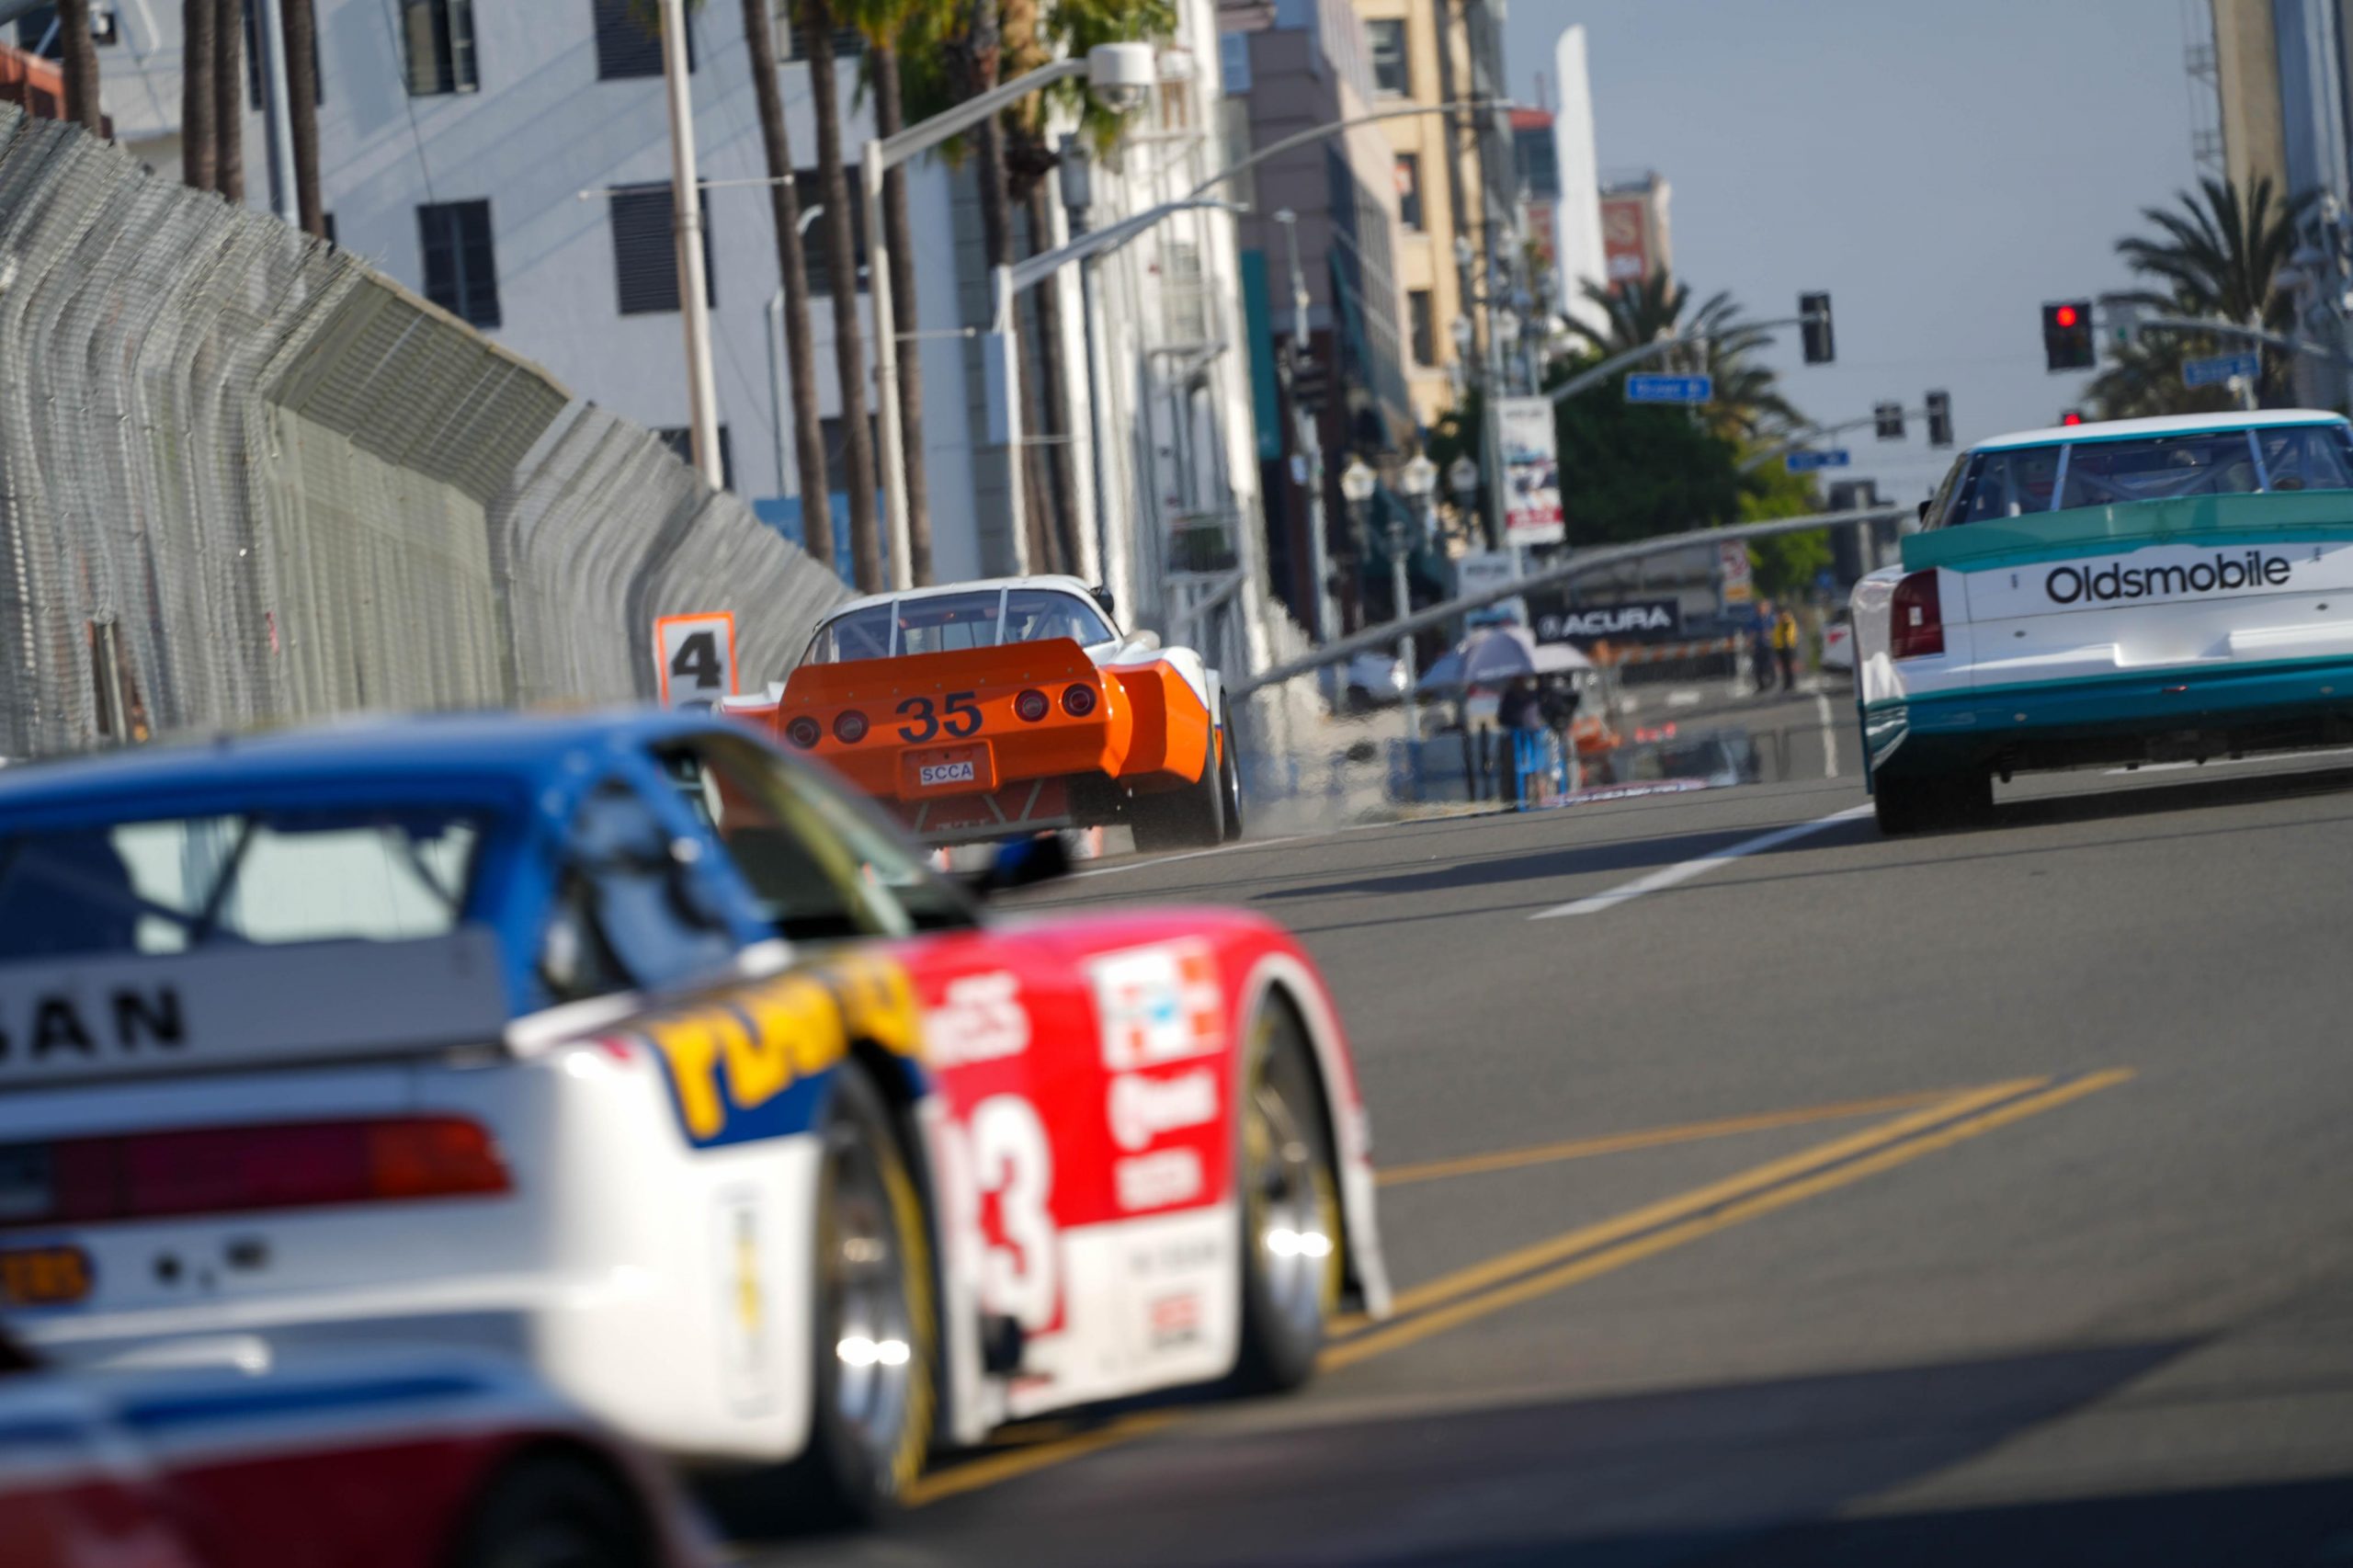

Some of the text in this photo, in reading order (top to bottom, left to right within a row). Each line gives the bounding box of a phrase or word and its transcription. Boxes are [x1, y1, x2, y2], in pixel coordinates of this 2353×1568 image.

[2046, 551, 2290, 604] Oldsmobile
[1563, 606, 1671, 636] ACURA
[672, 631, 722, 689] 4
[896, 691, 983, 744] 35
[922, 764, 972, 781] SCCA
[0, 982, 188, 1059] AN
